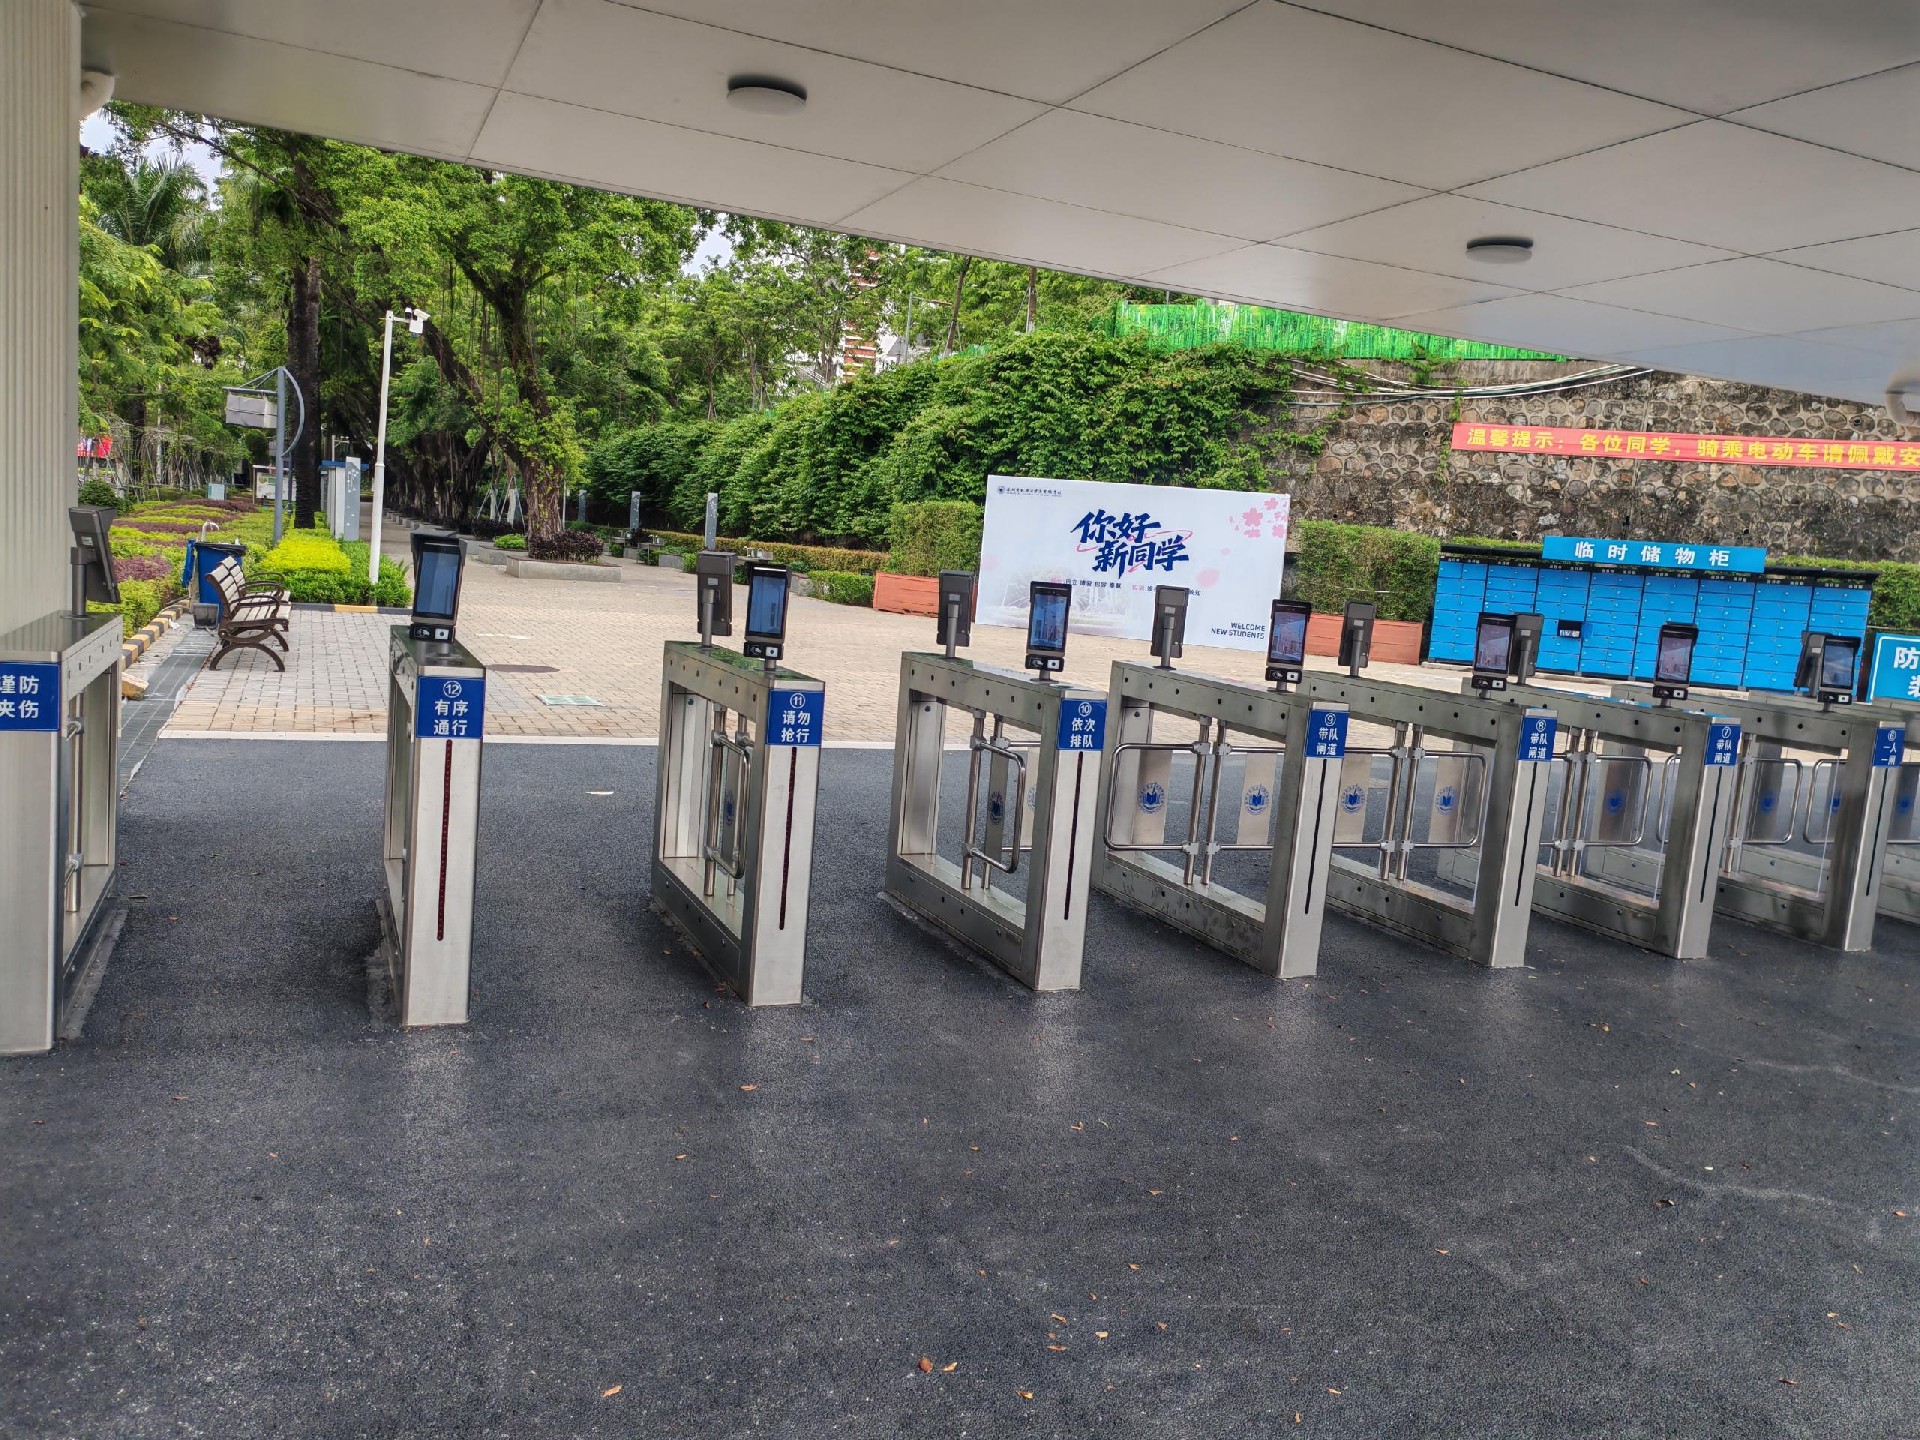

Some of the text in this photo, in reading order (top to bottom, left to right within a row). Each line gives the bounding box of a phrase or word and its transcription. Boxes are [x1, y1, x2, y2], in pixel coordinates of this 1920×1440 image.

[1070, 509, 1162, 544] 你好
[1092, 535, 1189, 579] 新同学
[1574, 541, 1731, 567] 临时储物柜
[1211, 628, 1265, 640] NEW STUDENTS
[1230, 622, 1266, 632] WELCOME
[434, 699, 469, 716] 有序
[782, 710, 811, 725] 请勿
[1071, 717, 1096, 732] 依次
[434, 719, 468, 736] 通行
[1318, 727, 1339, 740] 带队
[781, 727, 810, 743] 抢行
[1069, 734, 1093, 748] 排队
[1530, 732, 1548, 744] 带队
[1316, 742, 1338, 756] 闸道
[1716, 739, 1732, 751] 带队
[1883, 742, 1897, 753] 一人
[1528, 746, 1547, 759] 闸道
